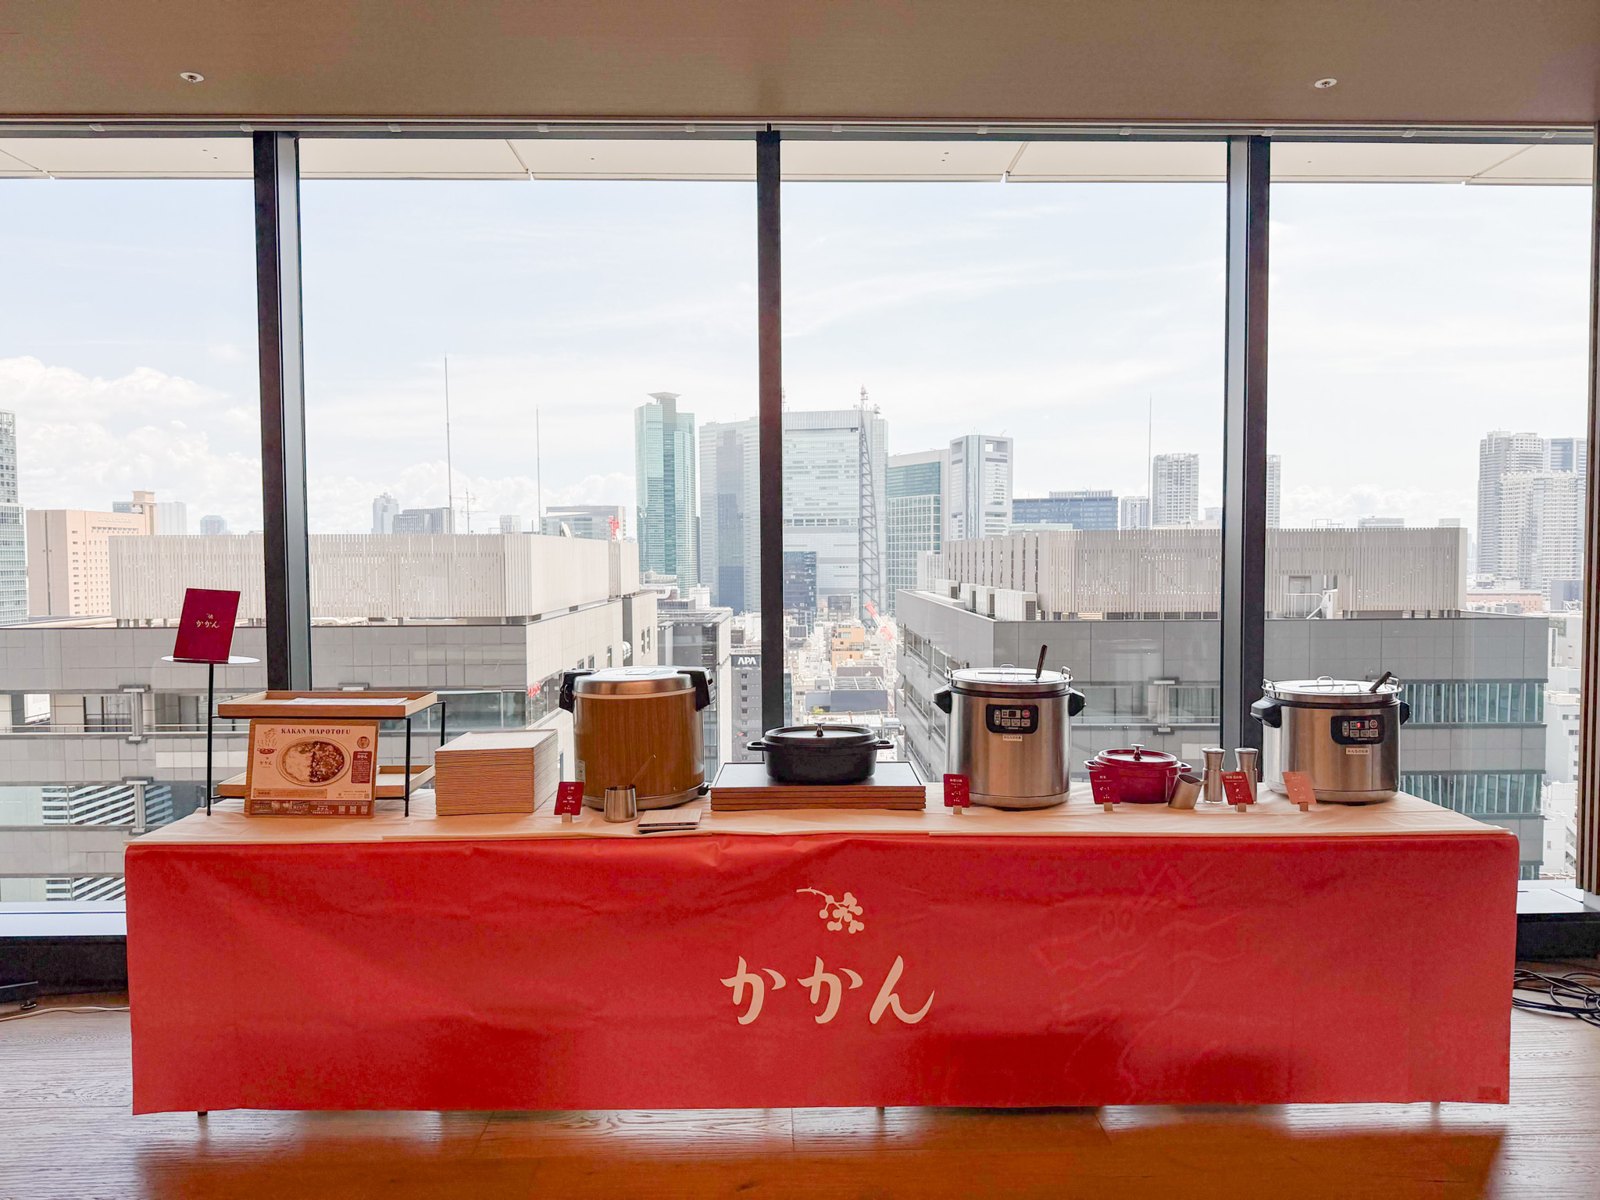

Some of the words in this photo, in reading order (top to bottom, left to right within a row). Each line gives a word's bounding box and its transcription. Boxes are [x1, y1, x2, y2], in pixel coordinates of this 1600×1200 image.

[196, 620, 220, 629] かかん
[737, 657, 757, 665] APA
[720, 955, 935, 1025] かかん
